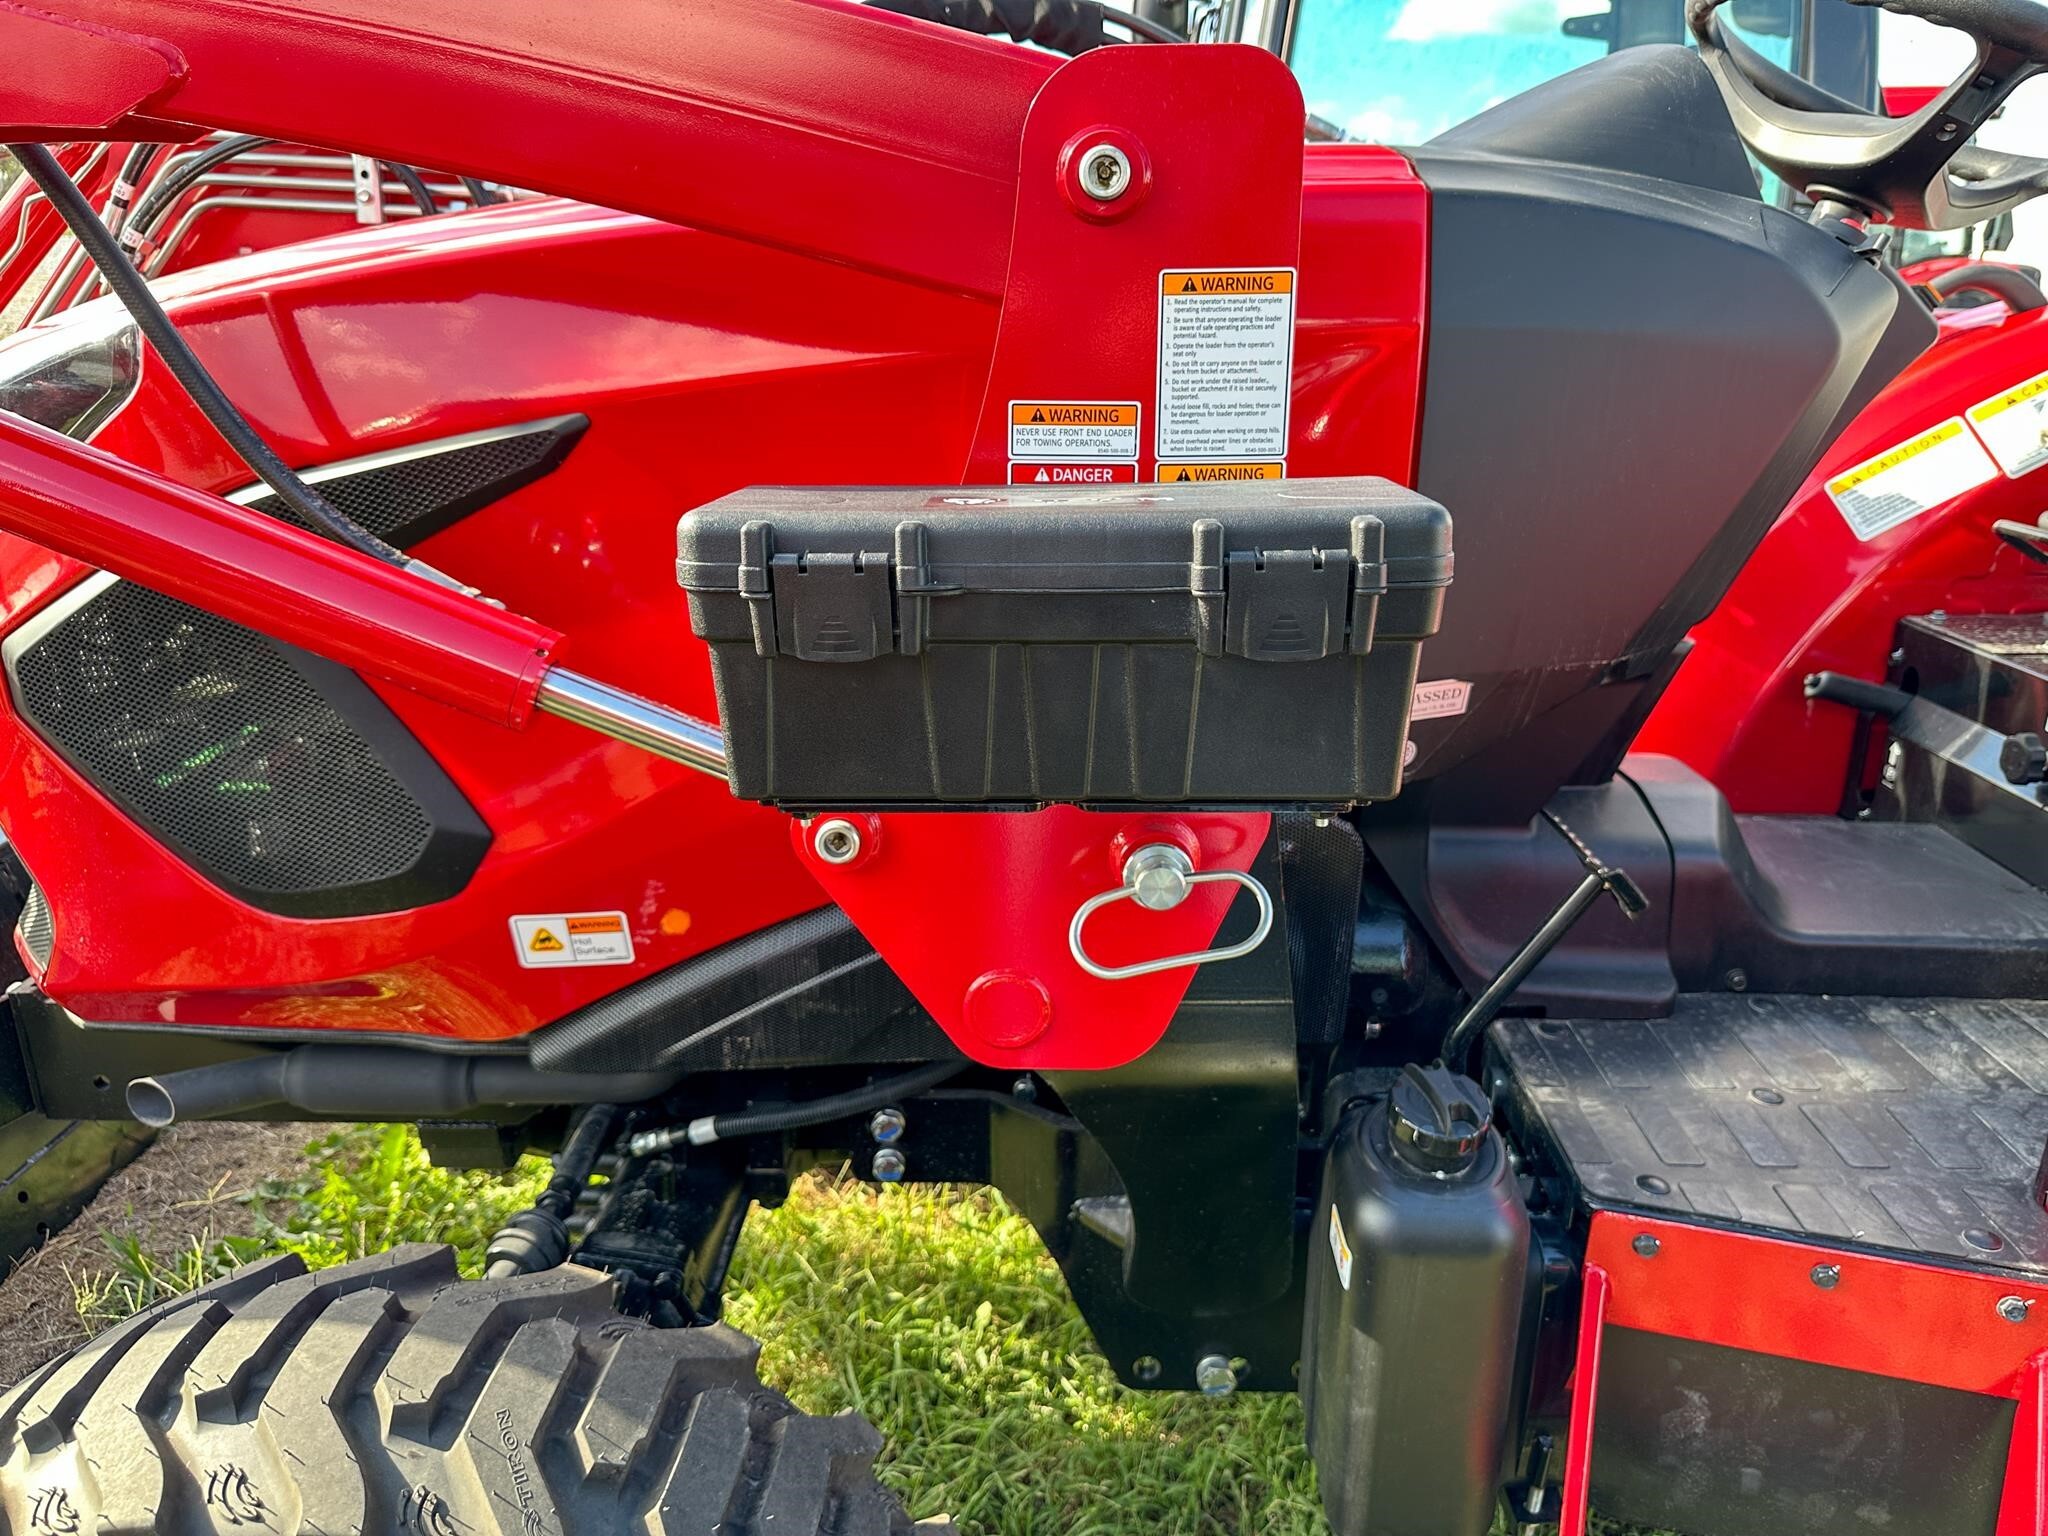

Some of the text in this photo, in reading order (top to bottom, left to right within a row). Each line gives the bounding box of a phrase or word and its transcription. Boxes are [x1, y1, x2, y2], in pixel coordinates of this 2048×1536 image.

[1201, 276, 1274, 291] WARNING
[1049, 409, 1119, 422] WARNING
[1016, 428, 1039, 436] NEVER
[1042, 428, 1056, 436] USE
[1060, 428, 1084, 436] FRONT
[1104, 429, 1133, 437] LOADER
[1034, 439, 1062, 447] TOWING
[1065, 439, 1112, 447] OPERATIONS.
[1867, 434, 1942, 476] CAUTION
[1053, 468, 1112, 482] DANGER
[1195, 468, 1264, 481] WARNING
[496, 1406, 534, 1509] TIRON
